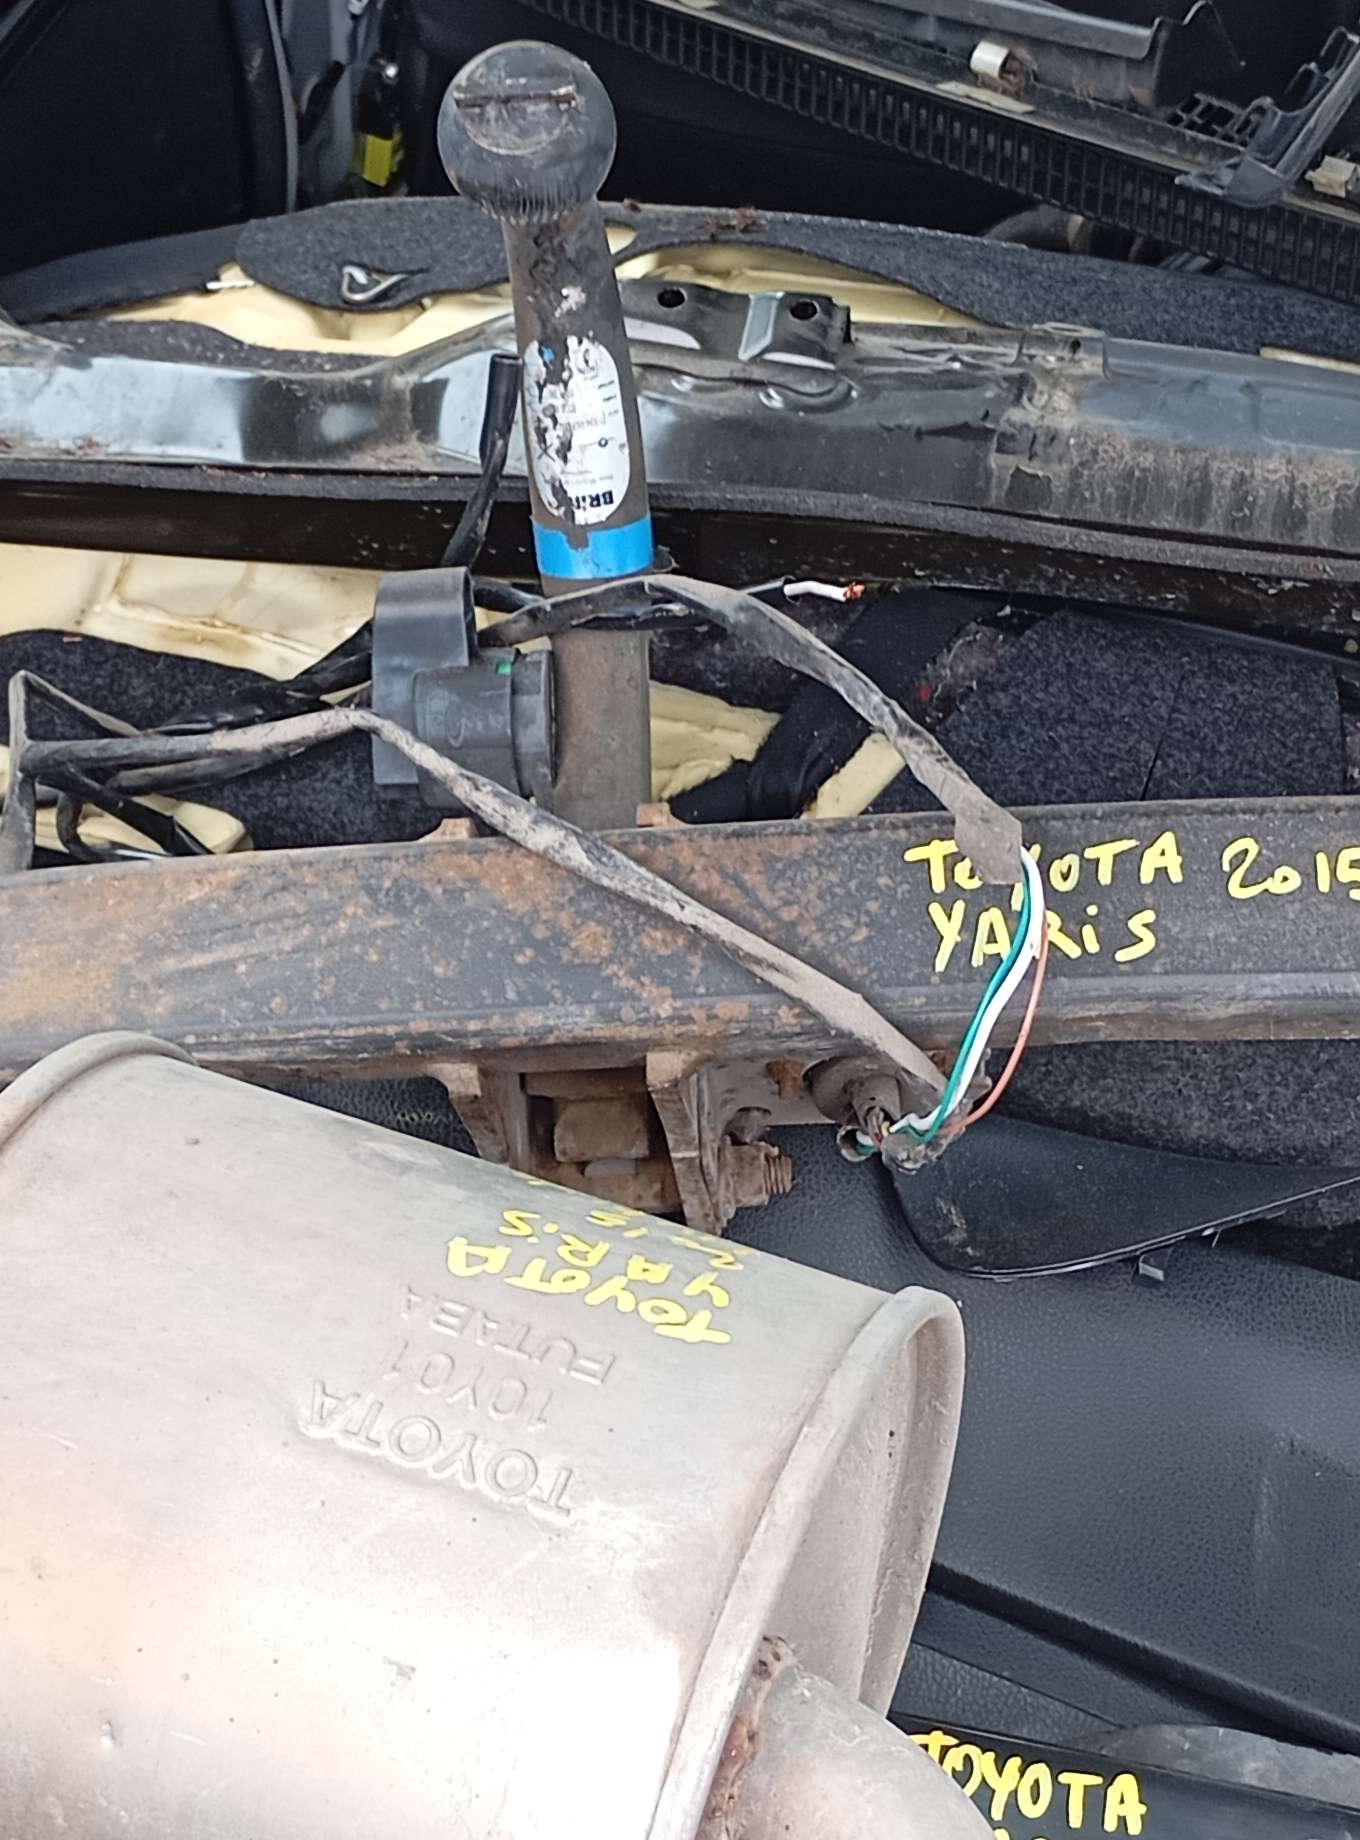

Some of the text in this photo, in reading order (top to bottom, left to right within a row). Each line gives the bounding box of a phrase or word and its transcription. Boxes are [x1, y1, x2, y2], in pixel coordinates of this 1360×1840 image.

[401, 1285, 616, 1385] FUTABA
[447, 1236, 731, 1344] TOYOTA
[301, 1379, 575, 1516] TOYOTA
[908, 1730, 1147, 1835] TOYOTA
